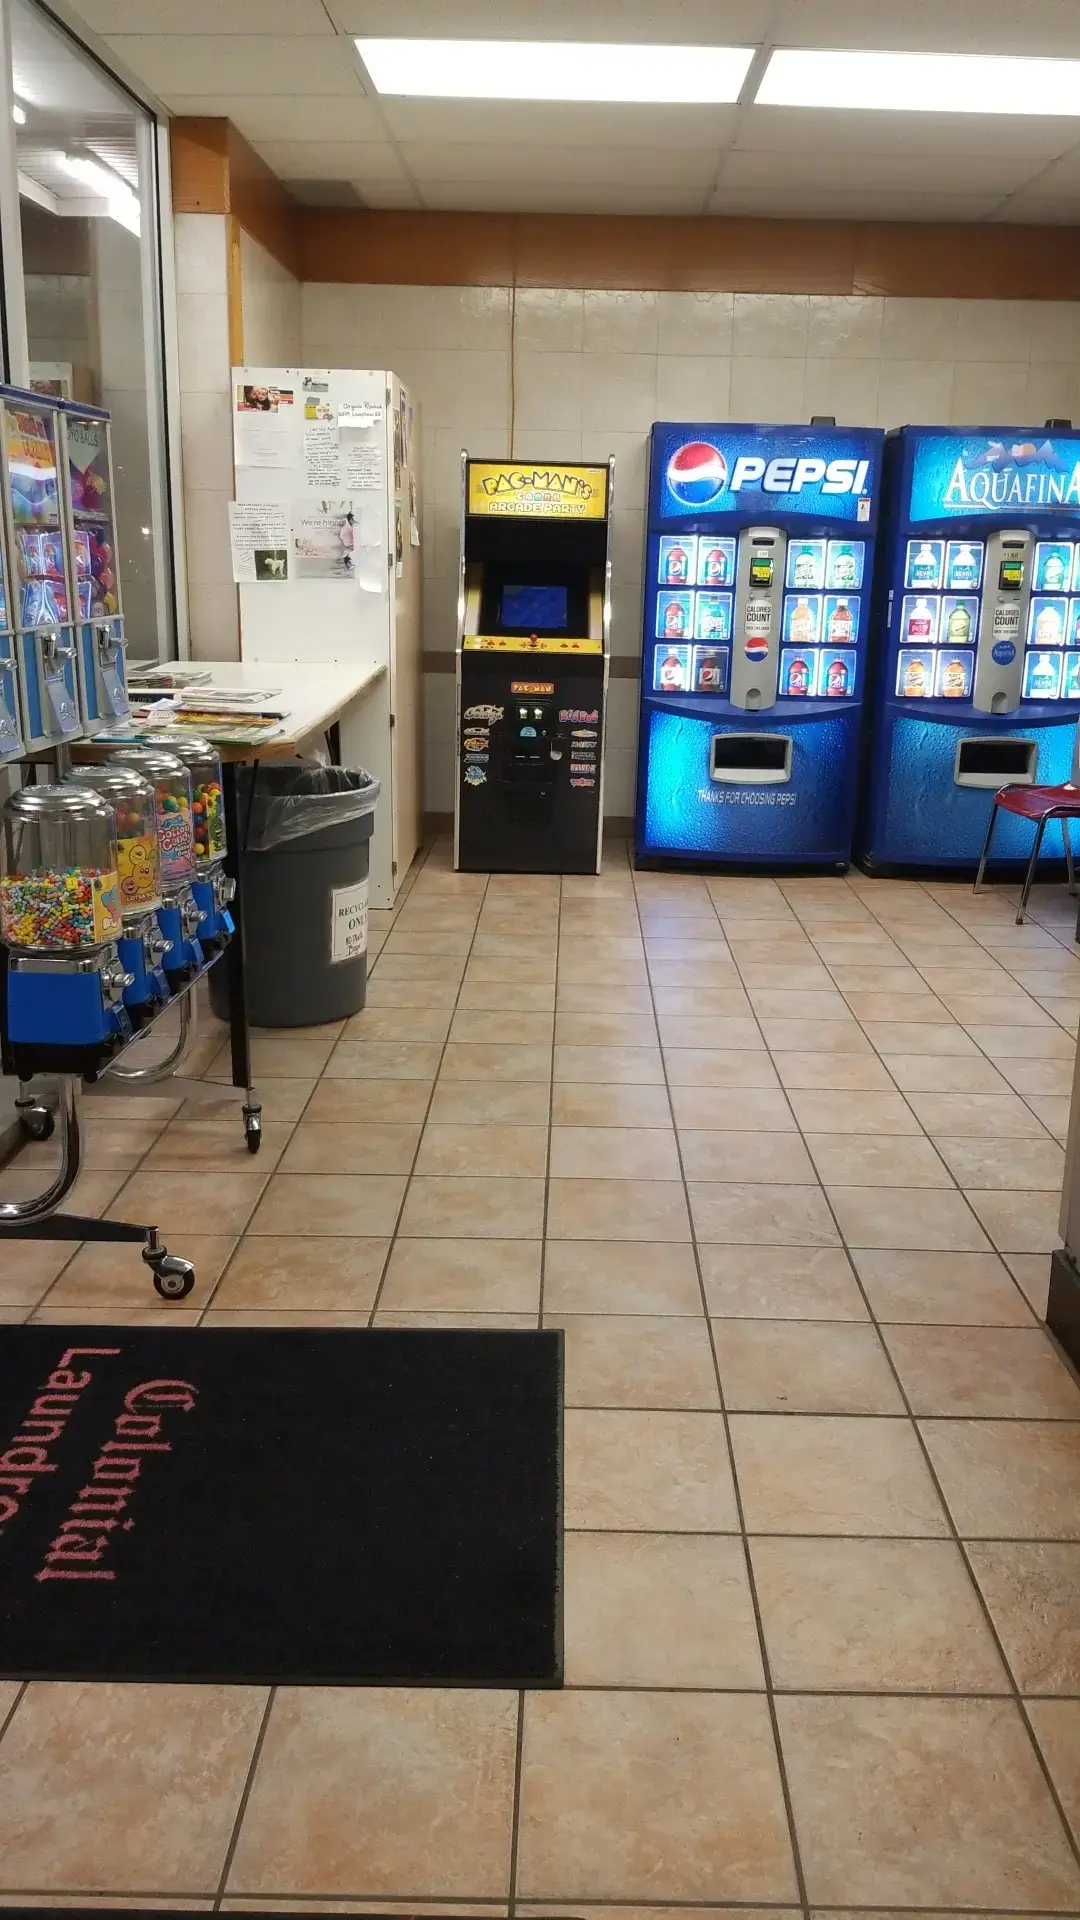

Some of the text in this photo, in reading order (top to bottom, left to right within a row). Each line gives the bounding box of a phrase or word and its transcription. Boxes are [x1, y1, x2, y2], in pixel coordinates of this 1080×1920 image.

[730, 456, 870, 495] PEPSI
[482, 471, 592, 500] PAC-MAN'S
[489, 501, 585, 514] ARCADE PARTY
[746, 605, 772, 613] CALORIES
[746, 613, 771, 622] COUNT
[994, 616, 1019, 626] COUNT
[513, 684, 552, 692] PAC-MAN
[697, 789, 797, 806] THANKS FOR CHOOSING PEPSI
[157, 824, 190, 842] Cotton
[162, 831, 192, 851] Candy
[126, 893, 146, 902] LOTSA
[34, 1379, 200, 1583] Colonial
